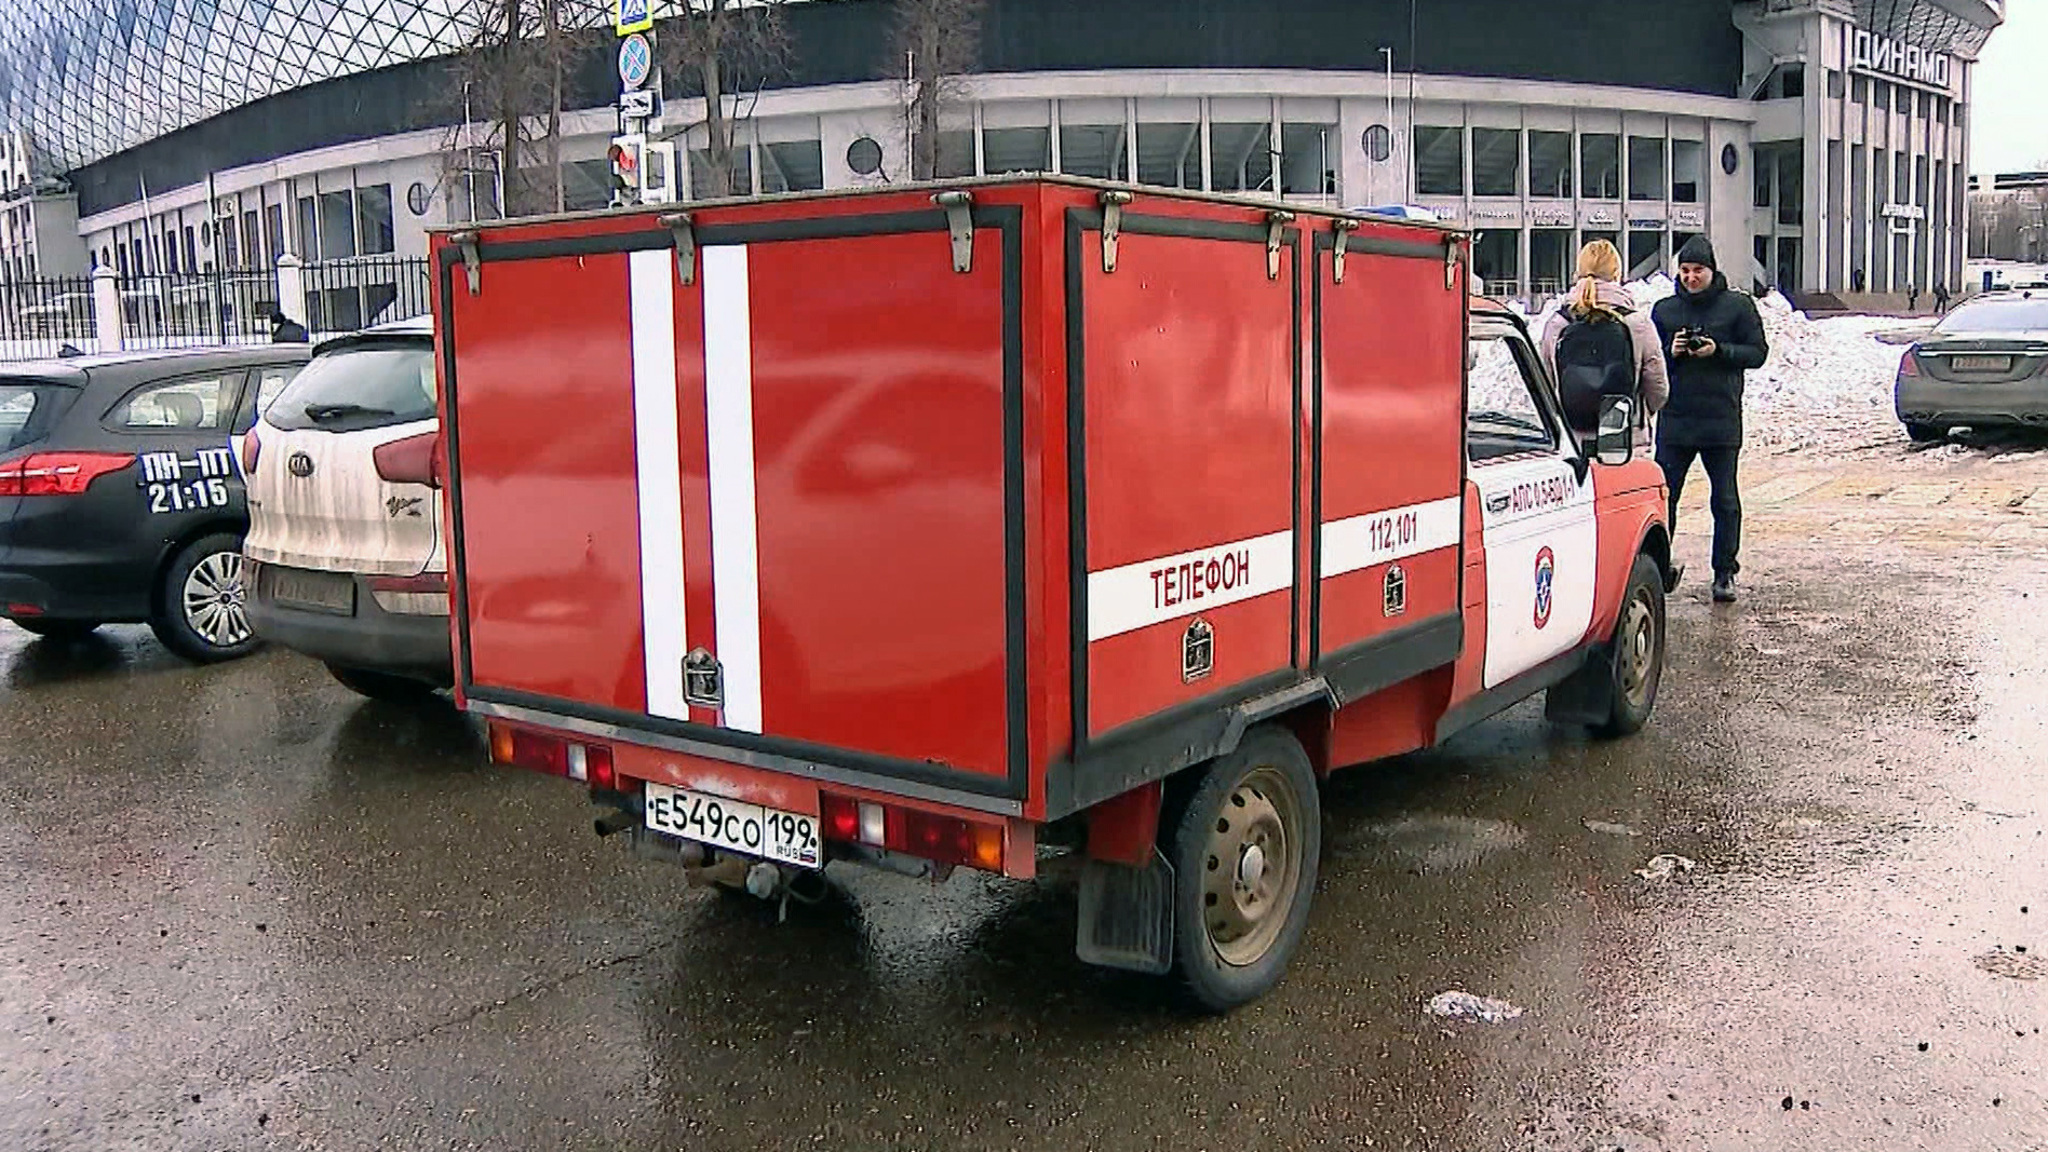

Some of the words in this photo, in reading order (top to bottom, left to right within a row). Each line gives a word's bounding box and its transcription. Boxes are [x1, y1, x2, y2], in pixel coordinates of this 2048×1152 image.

[1854, 28, 1950, 87] ДИНАМО
[148, 478, 228, 513] 21:15
[1369, 511, 1417, 553] 112,101
[1150, 549, 1249, 608] ТЕЛЕФОН
[768, 813, 812, 848] 199
[776, 846, 799, 859] RUS
